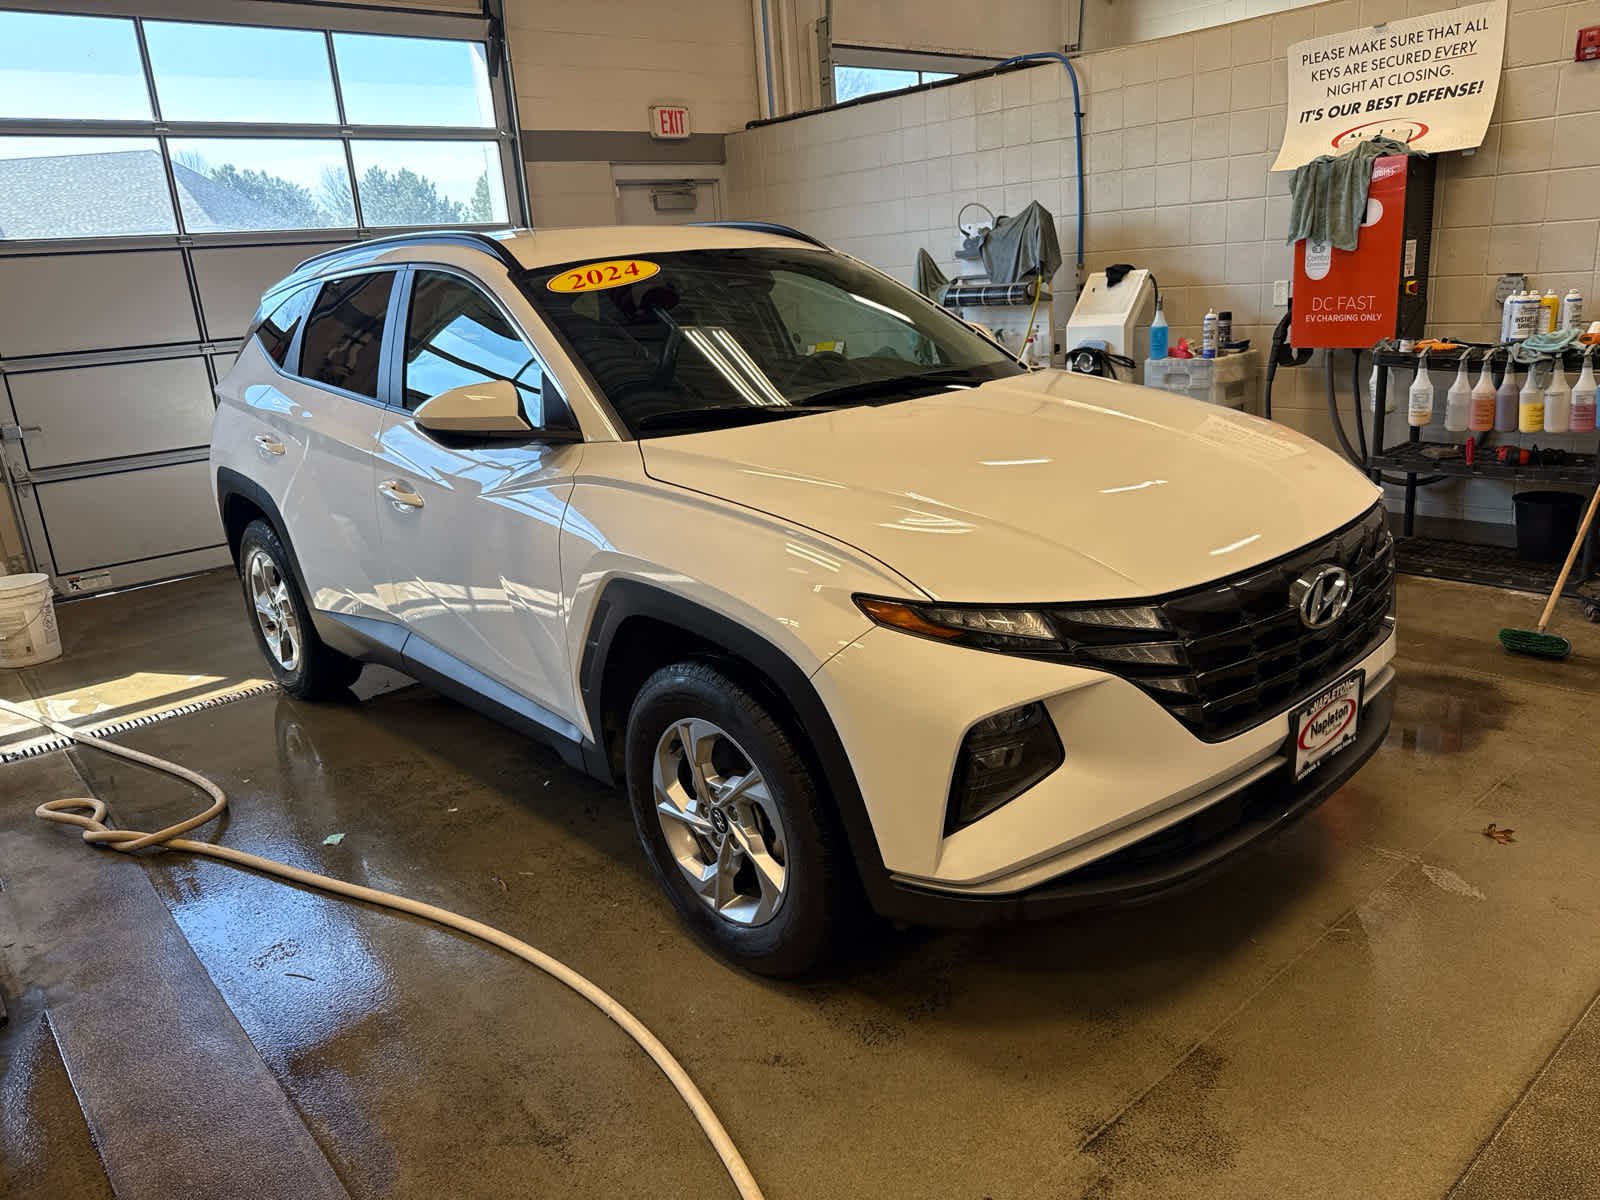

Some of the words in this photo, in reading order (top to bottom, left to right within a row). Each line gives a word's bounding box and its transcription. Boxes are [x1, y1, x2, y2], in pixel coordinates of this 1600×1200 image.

[1302, 46, 1345, 66] PLEASE
[1348, 38, 1386, 57] MAKE
[1389, 30, 1424, 49] SURE
[1427, 23, 1462, 41] THAT
[1464, 17, 1489, 34] ALL
[1311, 66, 1341, 82] KEYS
[1343, 61, 1368, 76] ARE
[1371, 49, 1432, 71] SECURED
[1434, 39, 1478, 60] EVERY
[1326, 79, 1368, 97] NIGHT
[1369, 76, 1386, 90] AT
[1387, 64, 1455, 87] CLOSING.
[1299, 107, 1325, 124] IT'S
[1328, 101, 1362, 119] OUR
[1365, 94, 1403, 113] BEST
[1406, 80, 1485, 106] DEFENSE!
[659, 109, 685, 135] EXIT
[567, 261, 640, 290] 2024
[1305, 314, 1316, 323] EV
[1316, 313, 1358, 322] CHARGING
[1360, 312, 1383, 322] ONLY
[1312, 296, 1334, 312] DC
[1337, 295, 1377, 311] FAST
[1310, 704, 1349, 740] Napleton
